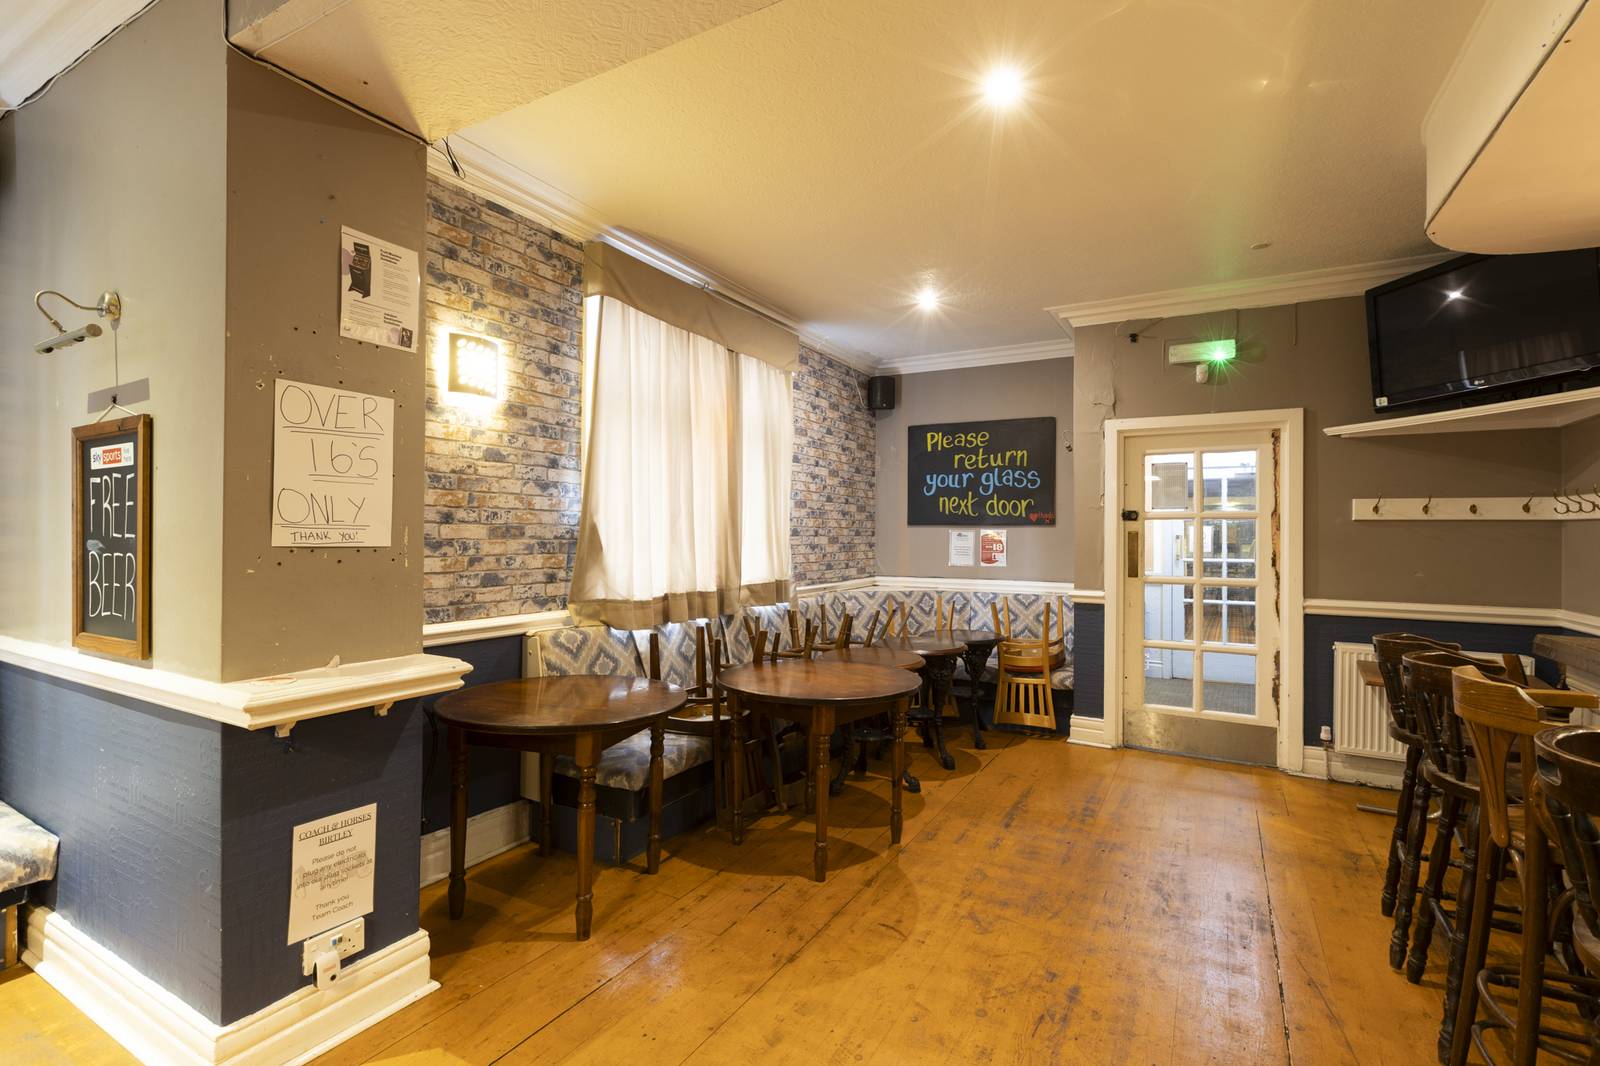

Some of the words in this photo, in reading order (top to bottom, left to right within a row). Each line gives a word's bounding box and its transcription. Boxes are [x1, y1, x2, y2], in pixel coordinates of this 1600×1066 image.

[280, 385, 384, 431] OVER
[926, 431, 990, 452] Please
[103, 451, 121, 463] sports
[954, 448, 1027, 469] return
[923, 472, 975, 496] your
[979, 468, 1041, 495] glass
[89, 473, 136, 538] FREE
[277, 487, 366, 524] ONLY
[938, 491, 980, 517] next
[985, 493, 1034, 517] door
[290, 531, 332, 542] THANK
[88, 551, 136, 623] BEER
[299, 824, 329, 841] COACH
[341, 812, 372, 828] HORSES
[319, 829, 353, 846] BIRTLEY
[312, 853, 335, 865] Please
[336, 849, 345, 857] do
[346, 845, 357, 854] not
[303, 868, 318, 879] plug
[320, 864, 333, 872] any
[312, 910, 331, 921] Team
[333, 902, 354, 913] Coach
[315, 899, 335, 910] Thank
[337, 895, 349, 904] you
